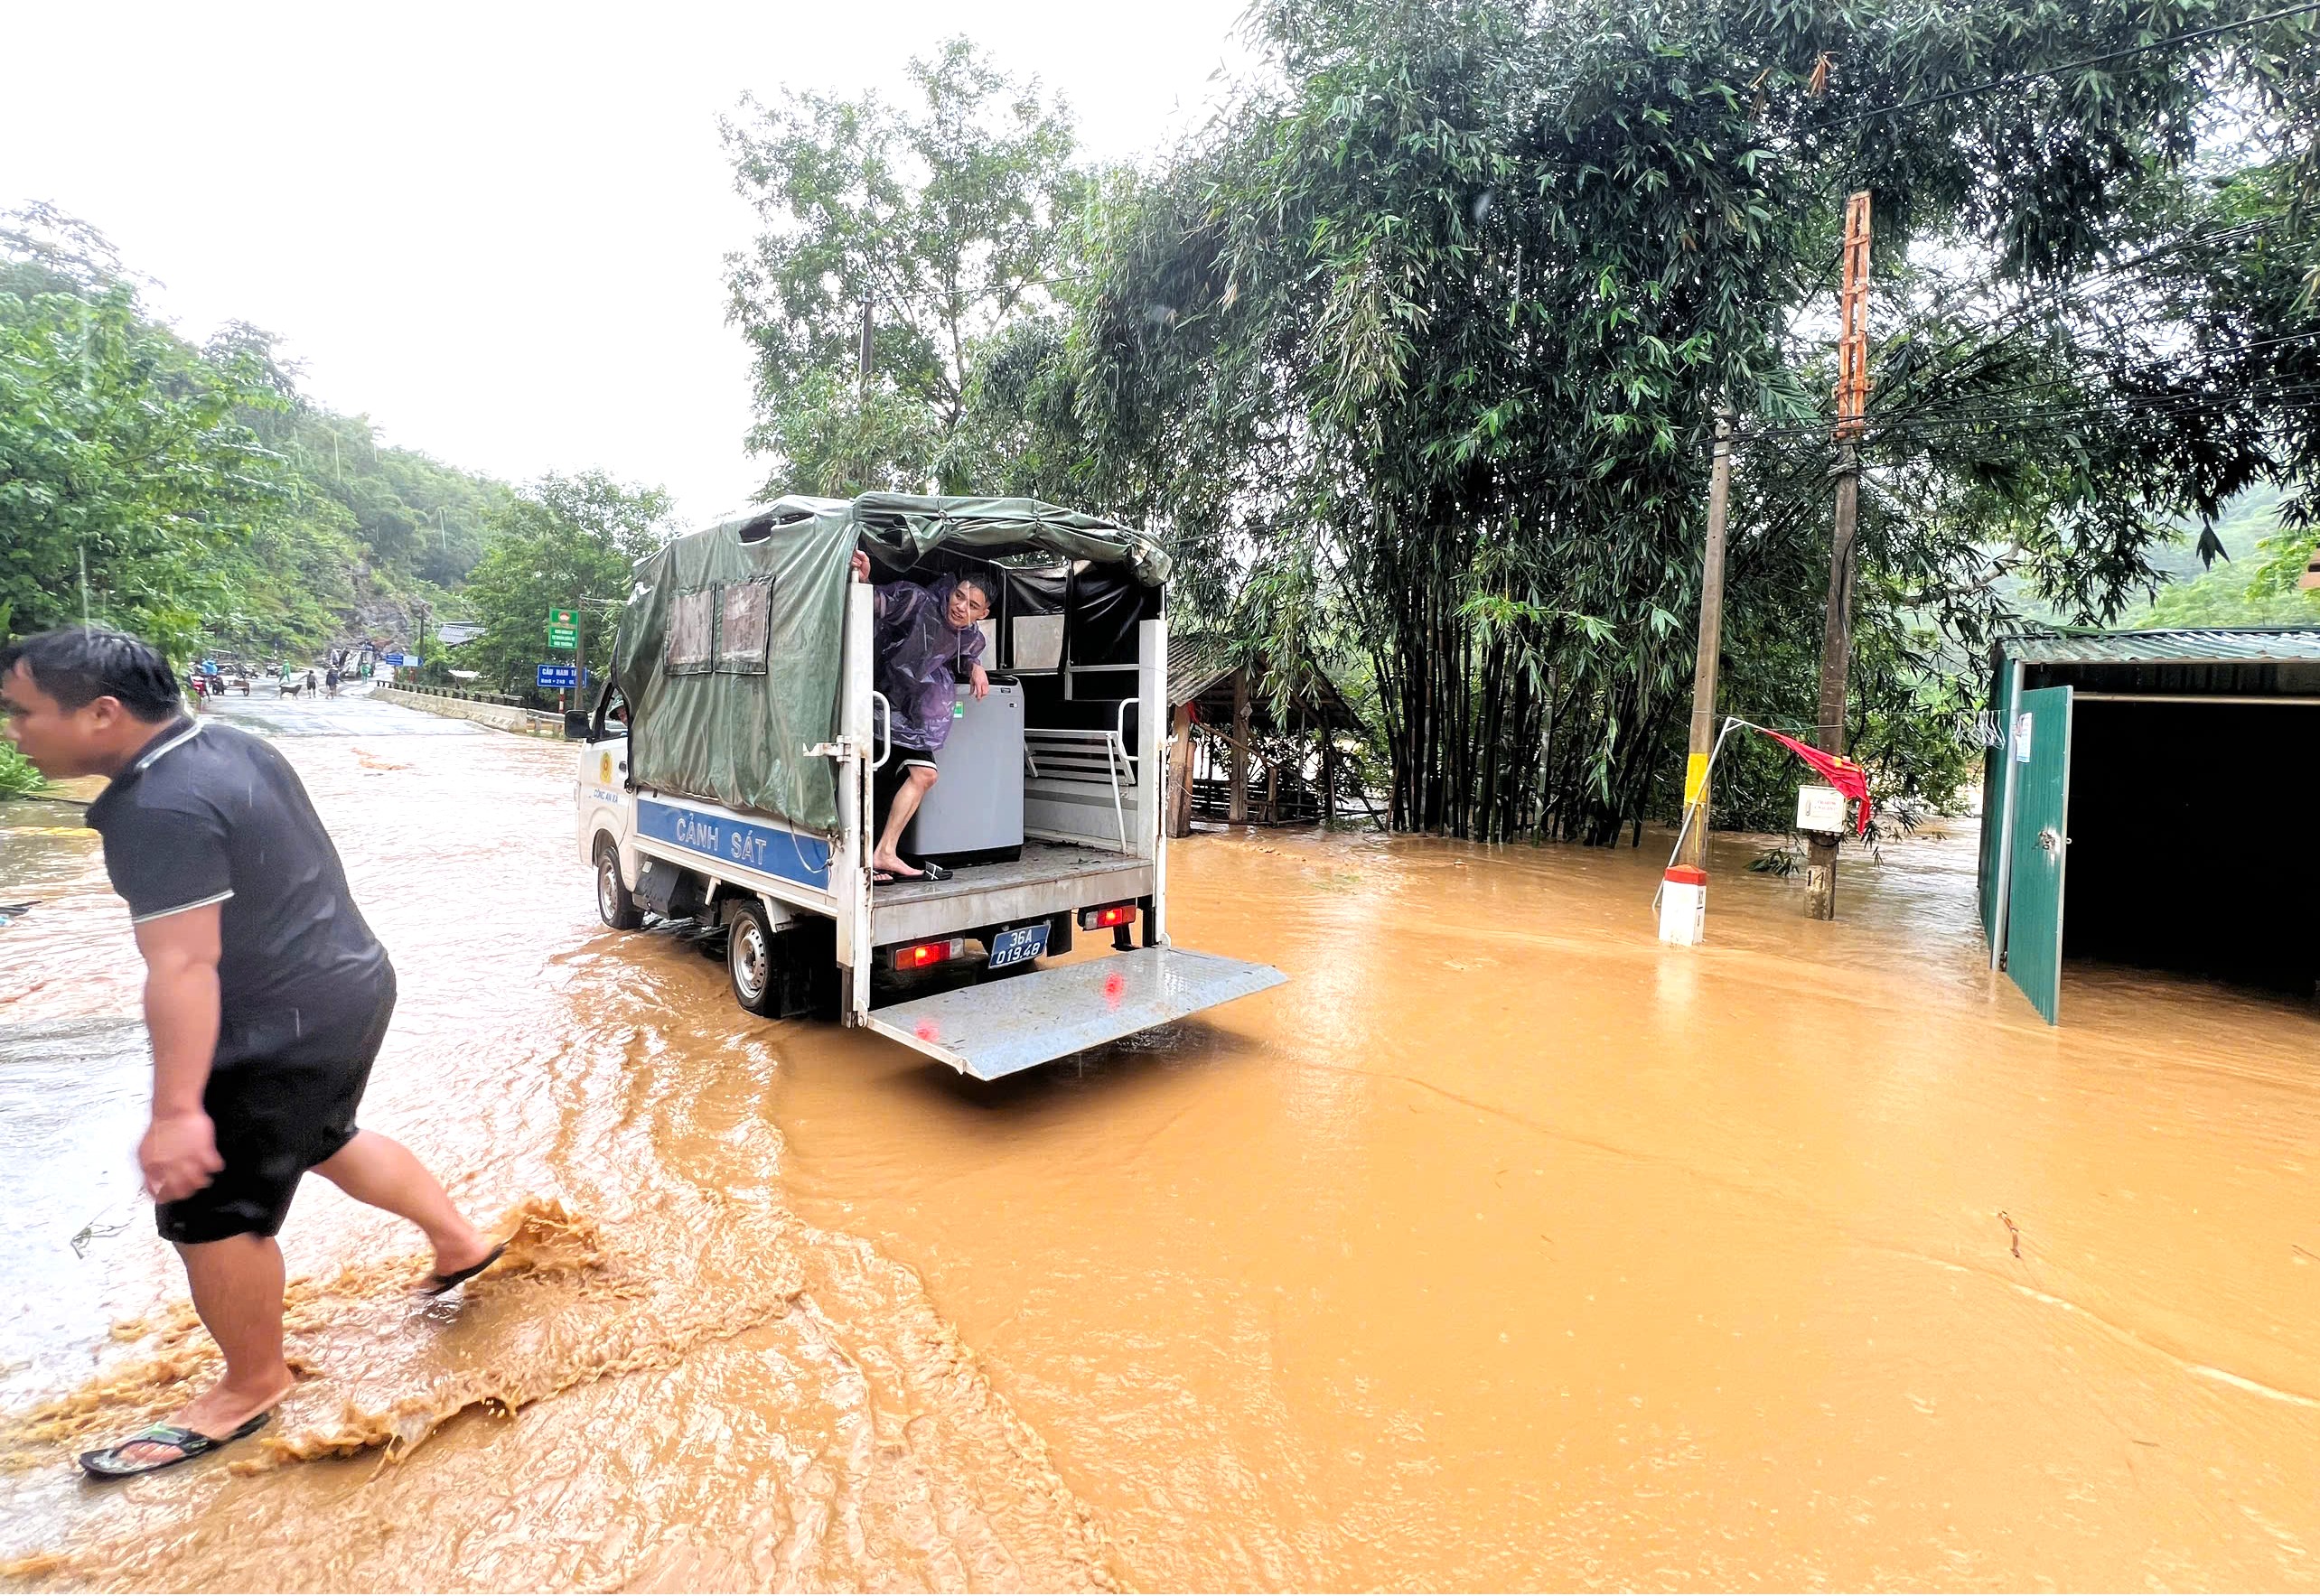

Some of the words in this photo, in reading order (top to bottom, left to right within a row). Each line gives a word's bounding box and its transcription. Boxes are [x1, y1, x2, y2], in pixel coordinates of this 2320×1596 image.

[676, 812, 719, 852] CẢNH
[731, 829, 767, 865] SÁT
[1009, 929, 1033, 947] 36A
[996, 942, 1041, 965] 019.48
